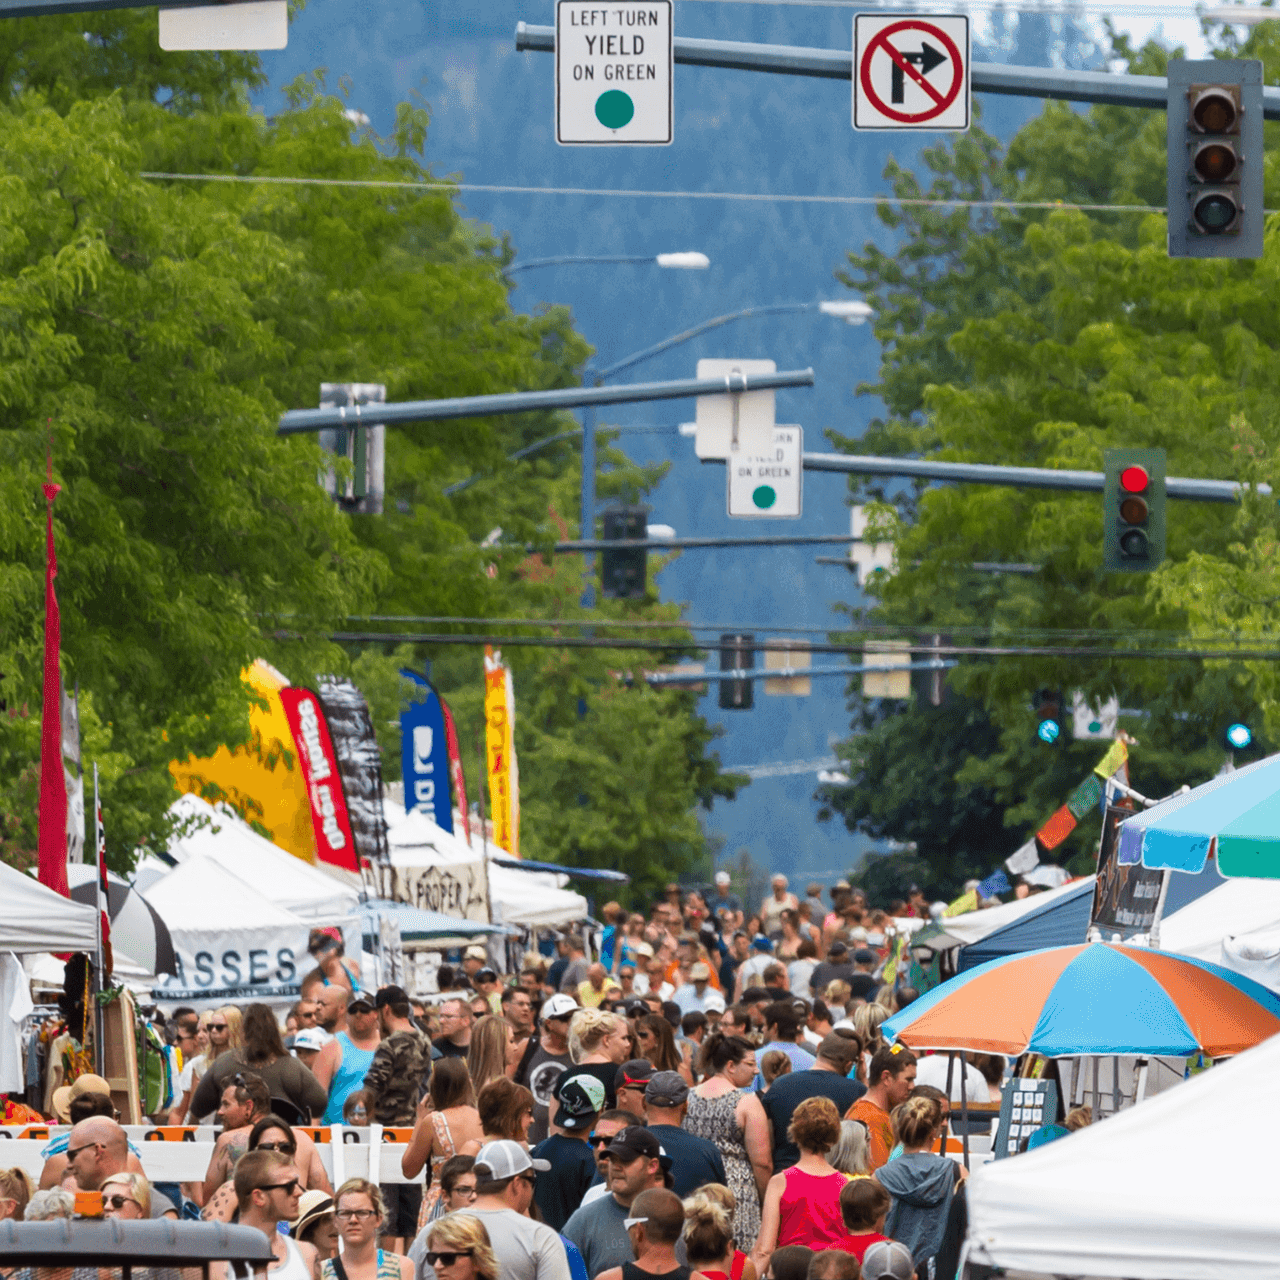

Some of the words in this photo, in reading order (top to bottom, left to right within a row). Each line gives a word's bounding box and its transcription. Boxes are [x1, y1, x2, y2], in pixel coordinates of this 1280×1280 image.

[571, 10, 608, 26] LEFT
[618, 10, 658, 26] TURN
[585, 34, 645, 55] YIELD
[573, 64, 595, 81] ON
[604, 64, 656, 81] GREEN
